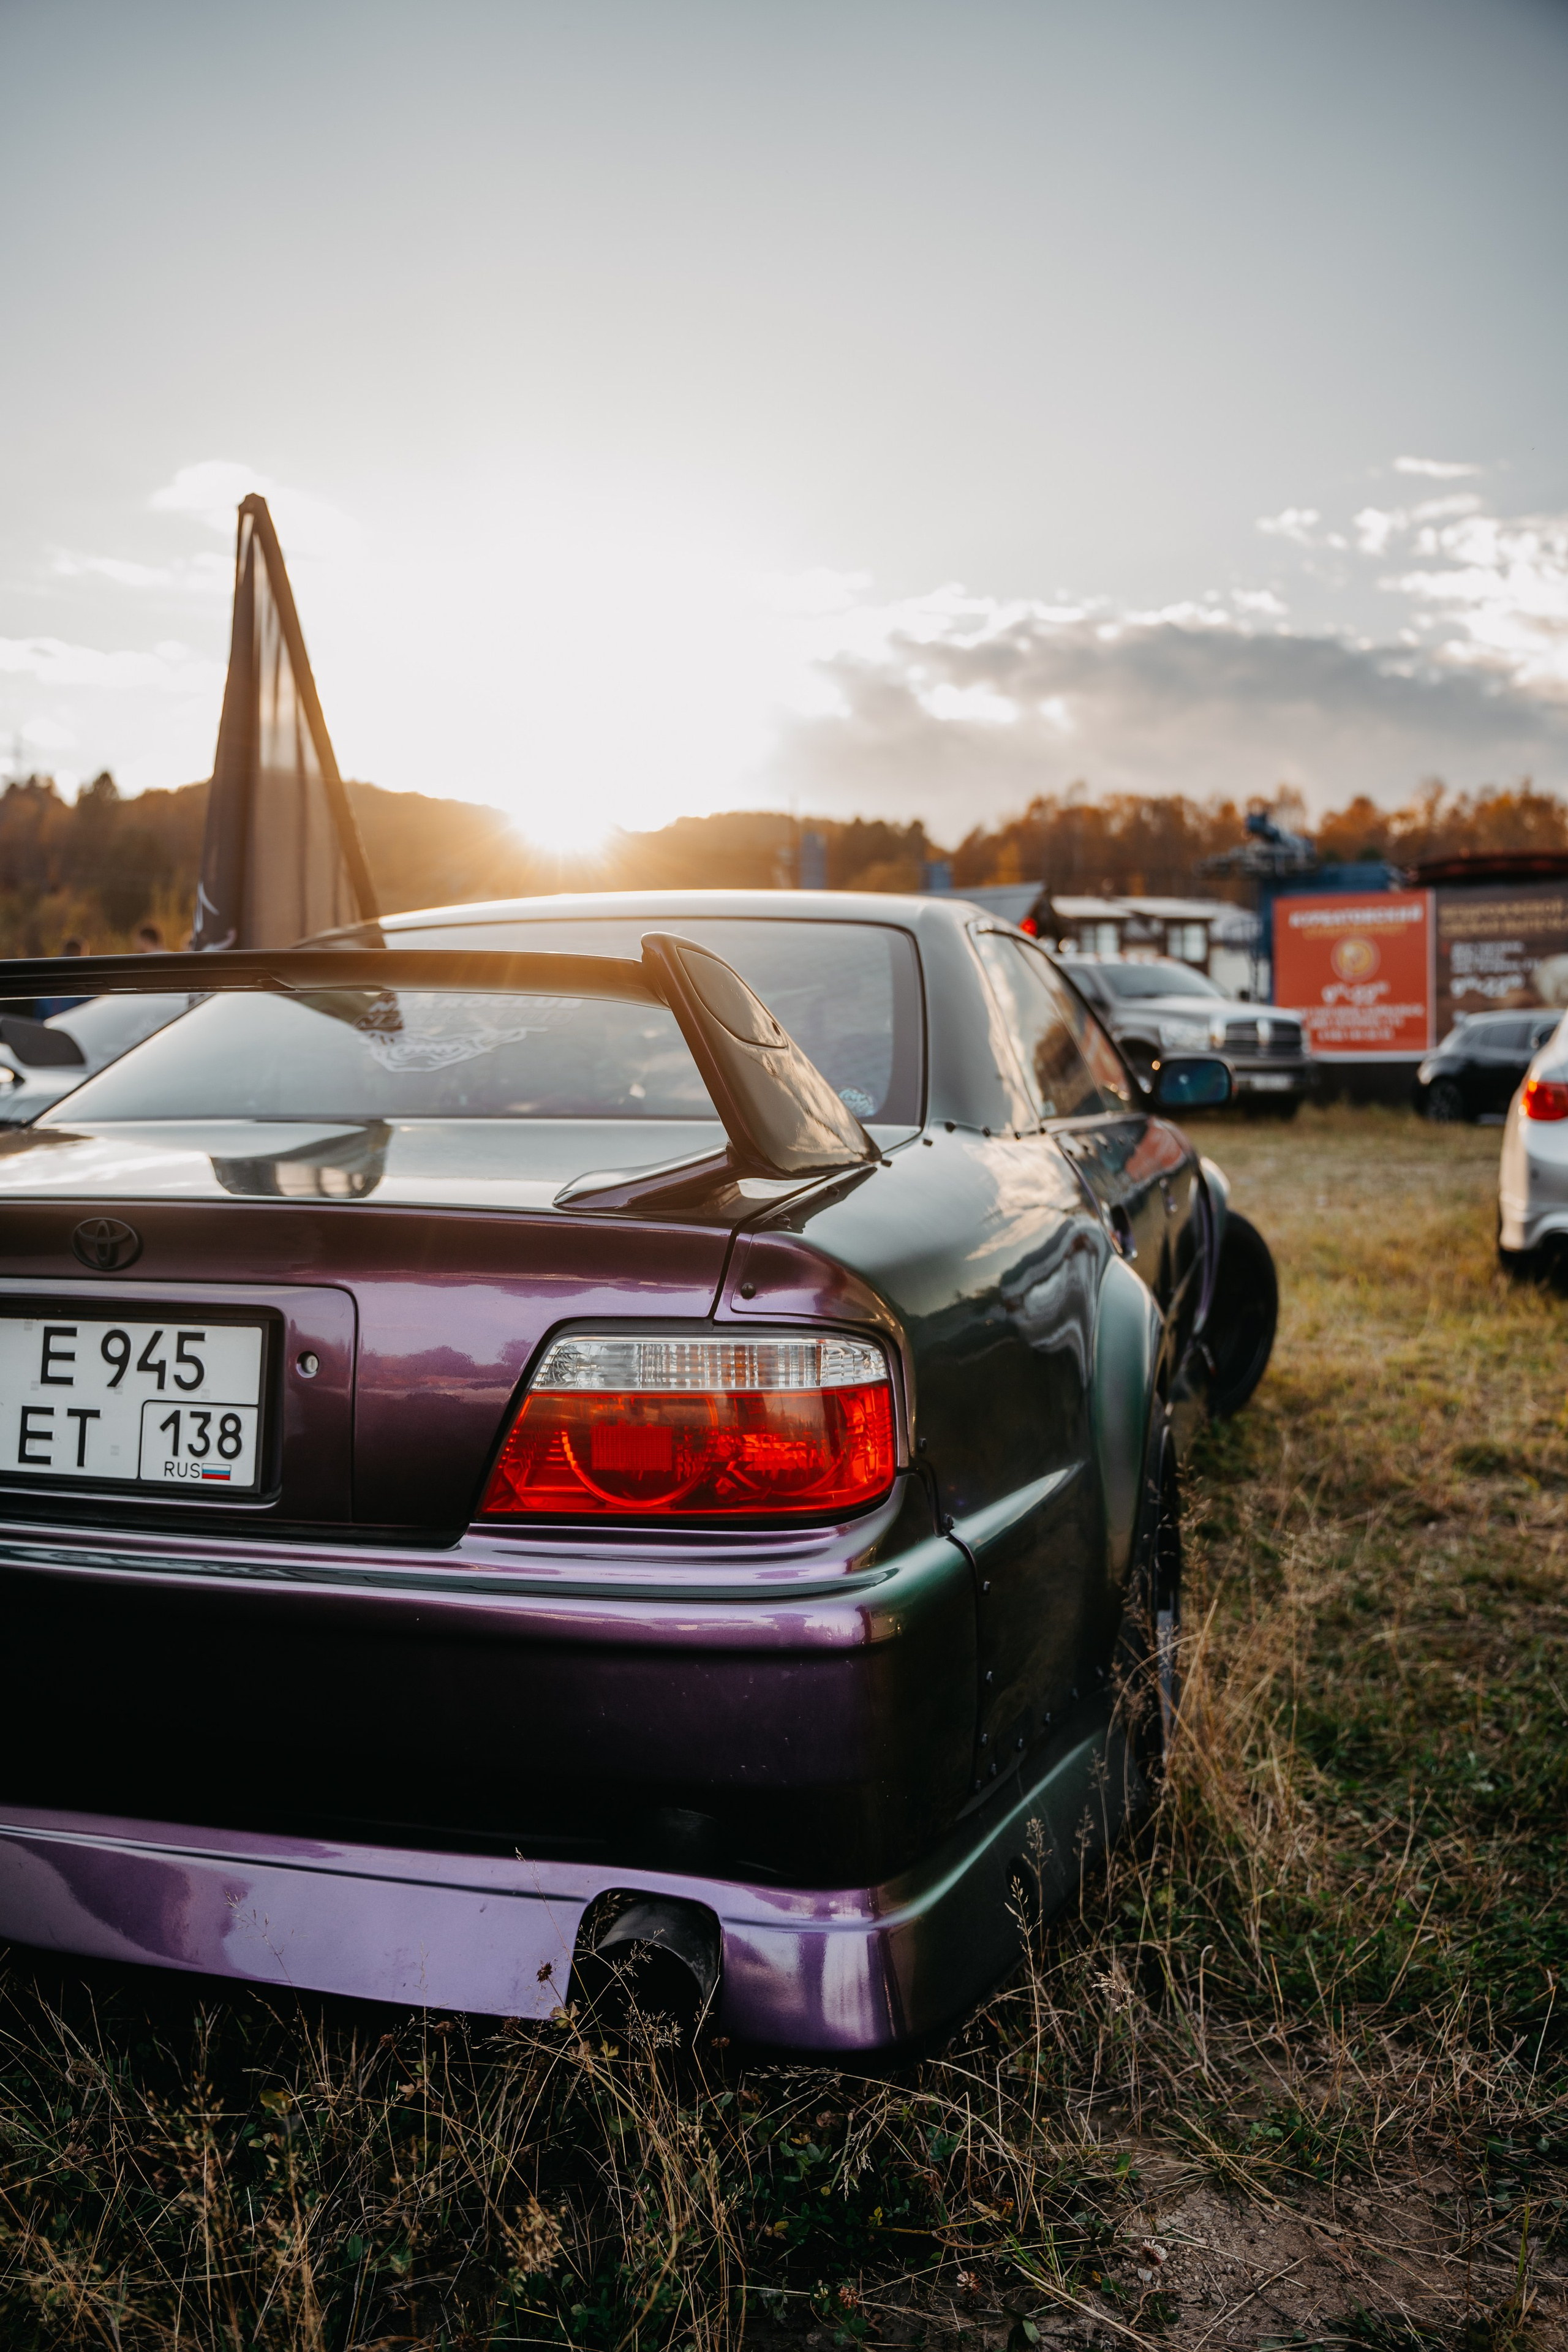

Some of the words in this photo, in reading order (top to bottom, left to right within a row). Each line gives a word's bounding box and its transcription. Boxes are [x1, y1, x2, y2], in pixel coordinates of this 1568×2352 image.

[100, 1329, 206, 1391] 945
[159, 1409, 243, 1460] 138
[164, 1461, 201, 1479] RUS
